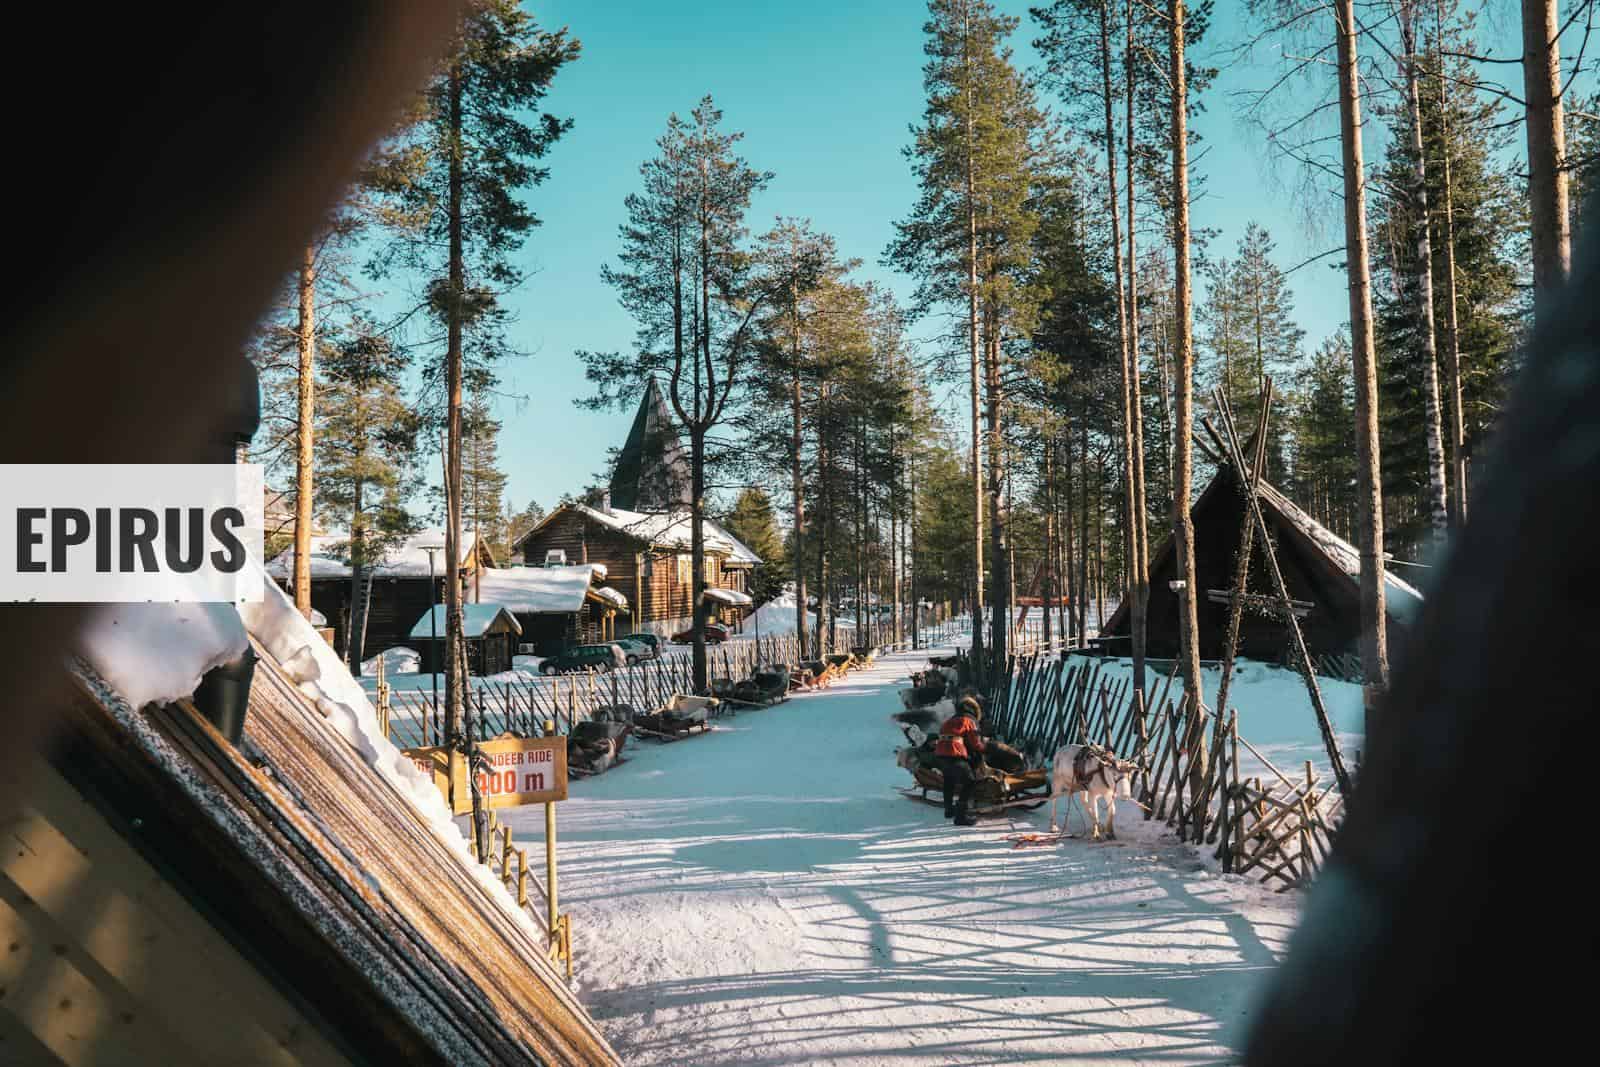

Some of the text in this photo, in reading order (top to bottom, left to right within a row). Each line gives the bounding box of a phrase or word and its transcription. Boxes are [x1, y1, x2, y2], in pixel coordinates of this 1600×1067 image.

[527, 750, 552, 764] RIDE
[478, 770, 544, 795] 400 m
